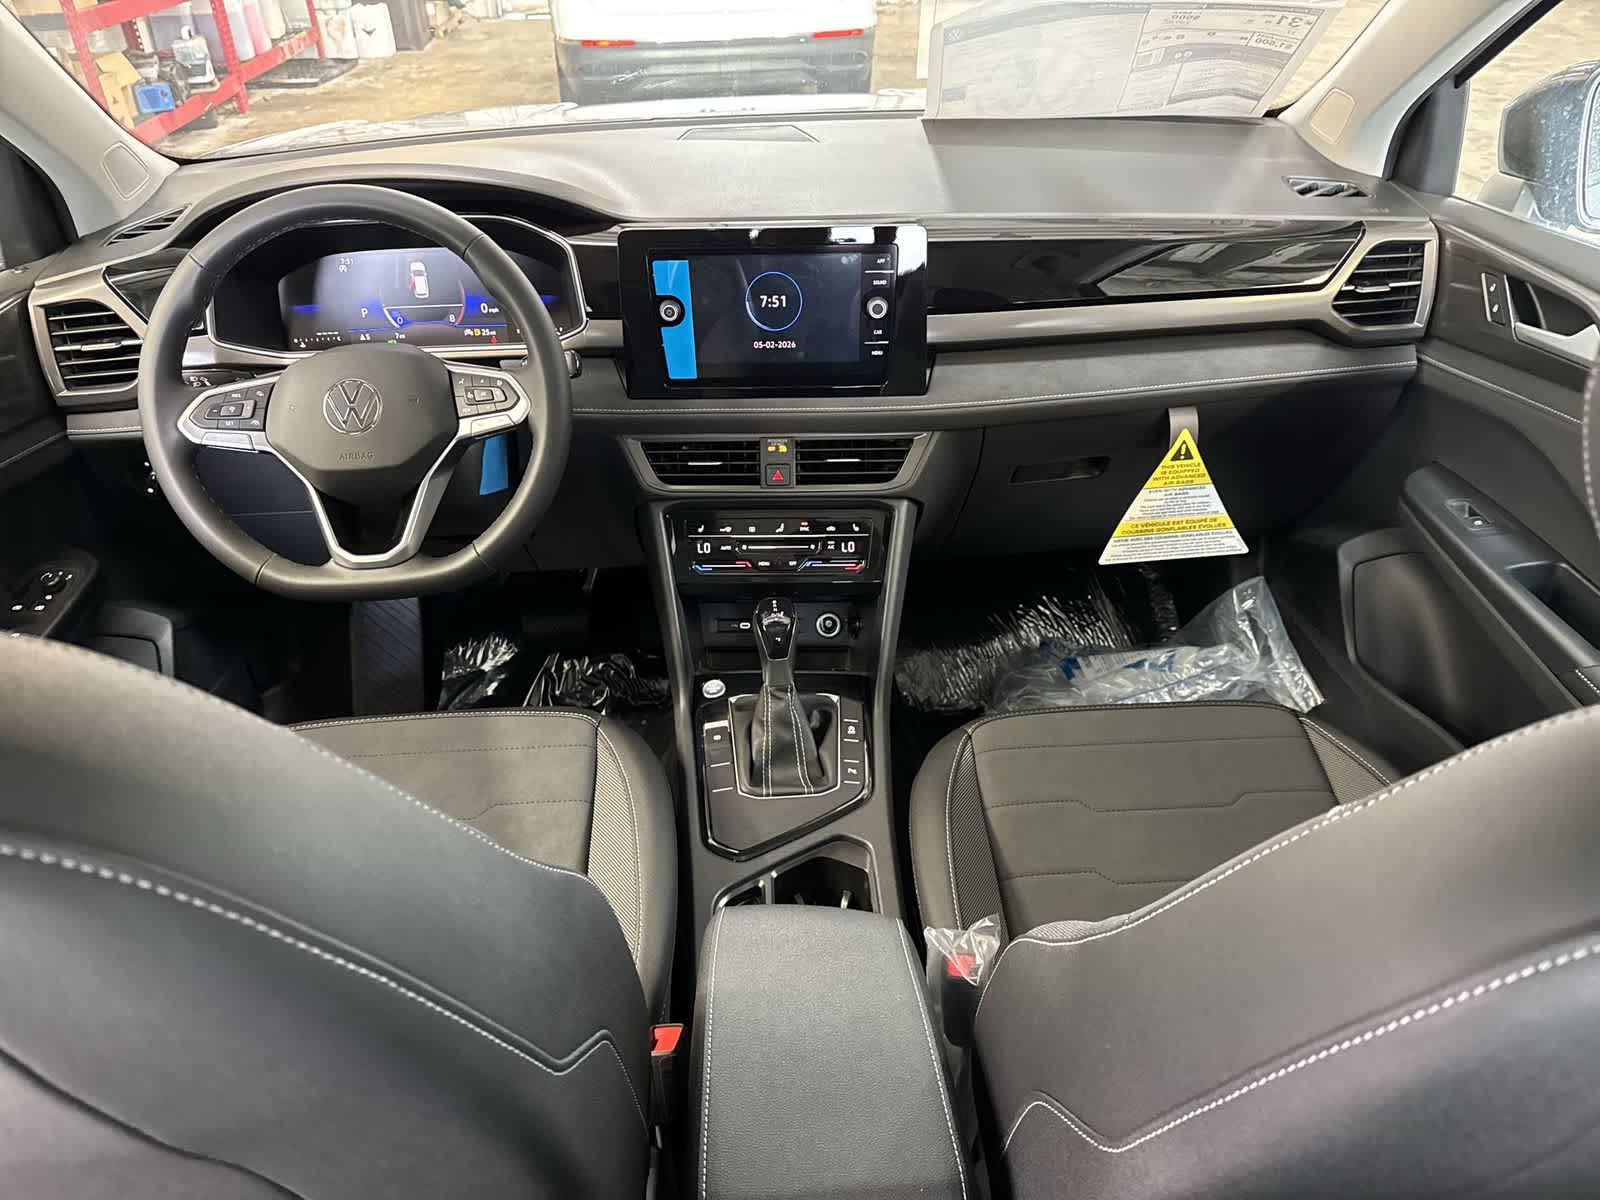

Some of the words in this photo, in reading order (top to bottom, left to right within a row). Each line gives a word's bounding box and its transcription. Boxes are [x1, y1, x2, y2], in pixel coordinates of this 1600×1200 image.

[759, 295, 787, 308] 7:51
[360, 307, 369, 319] P
[480, 302, 489, 314] 0
[753, 340, 797, 349] 05-02-2026
[338, 450, 376, 461] AIRBAG
[697, 542, 711, 554] LO
[841, 541, 856, 553] LO
